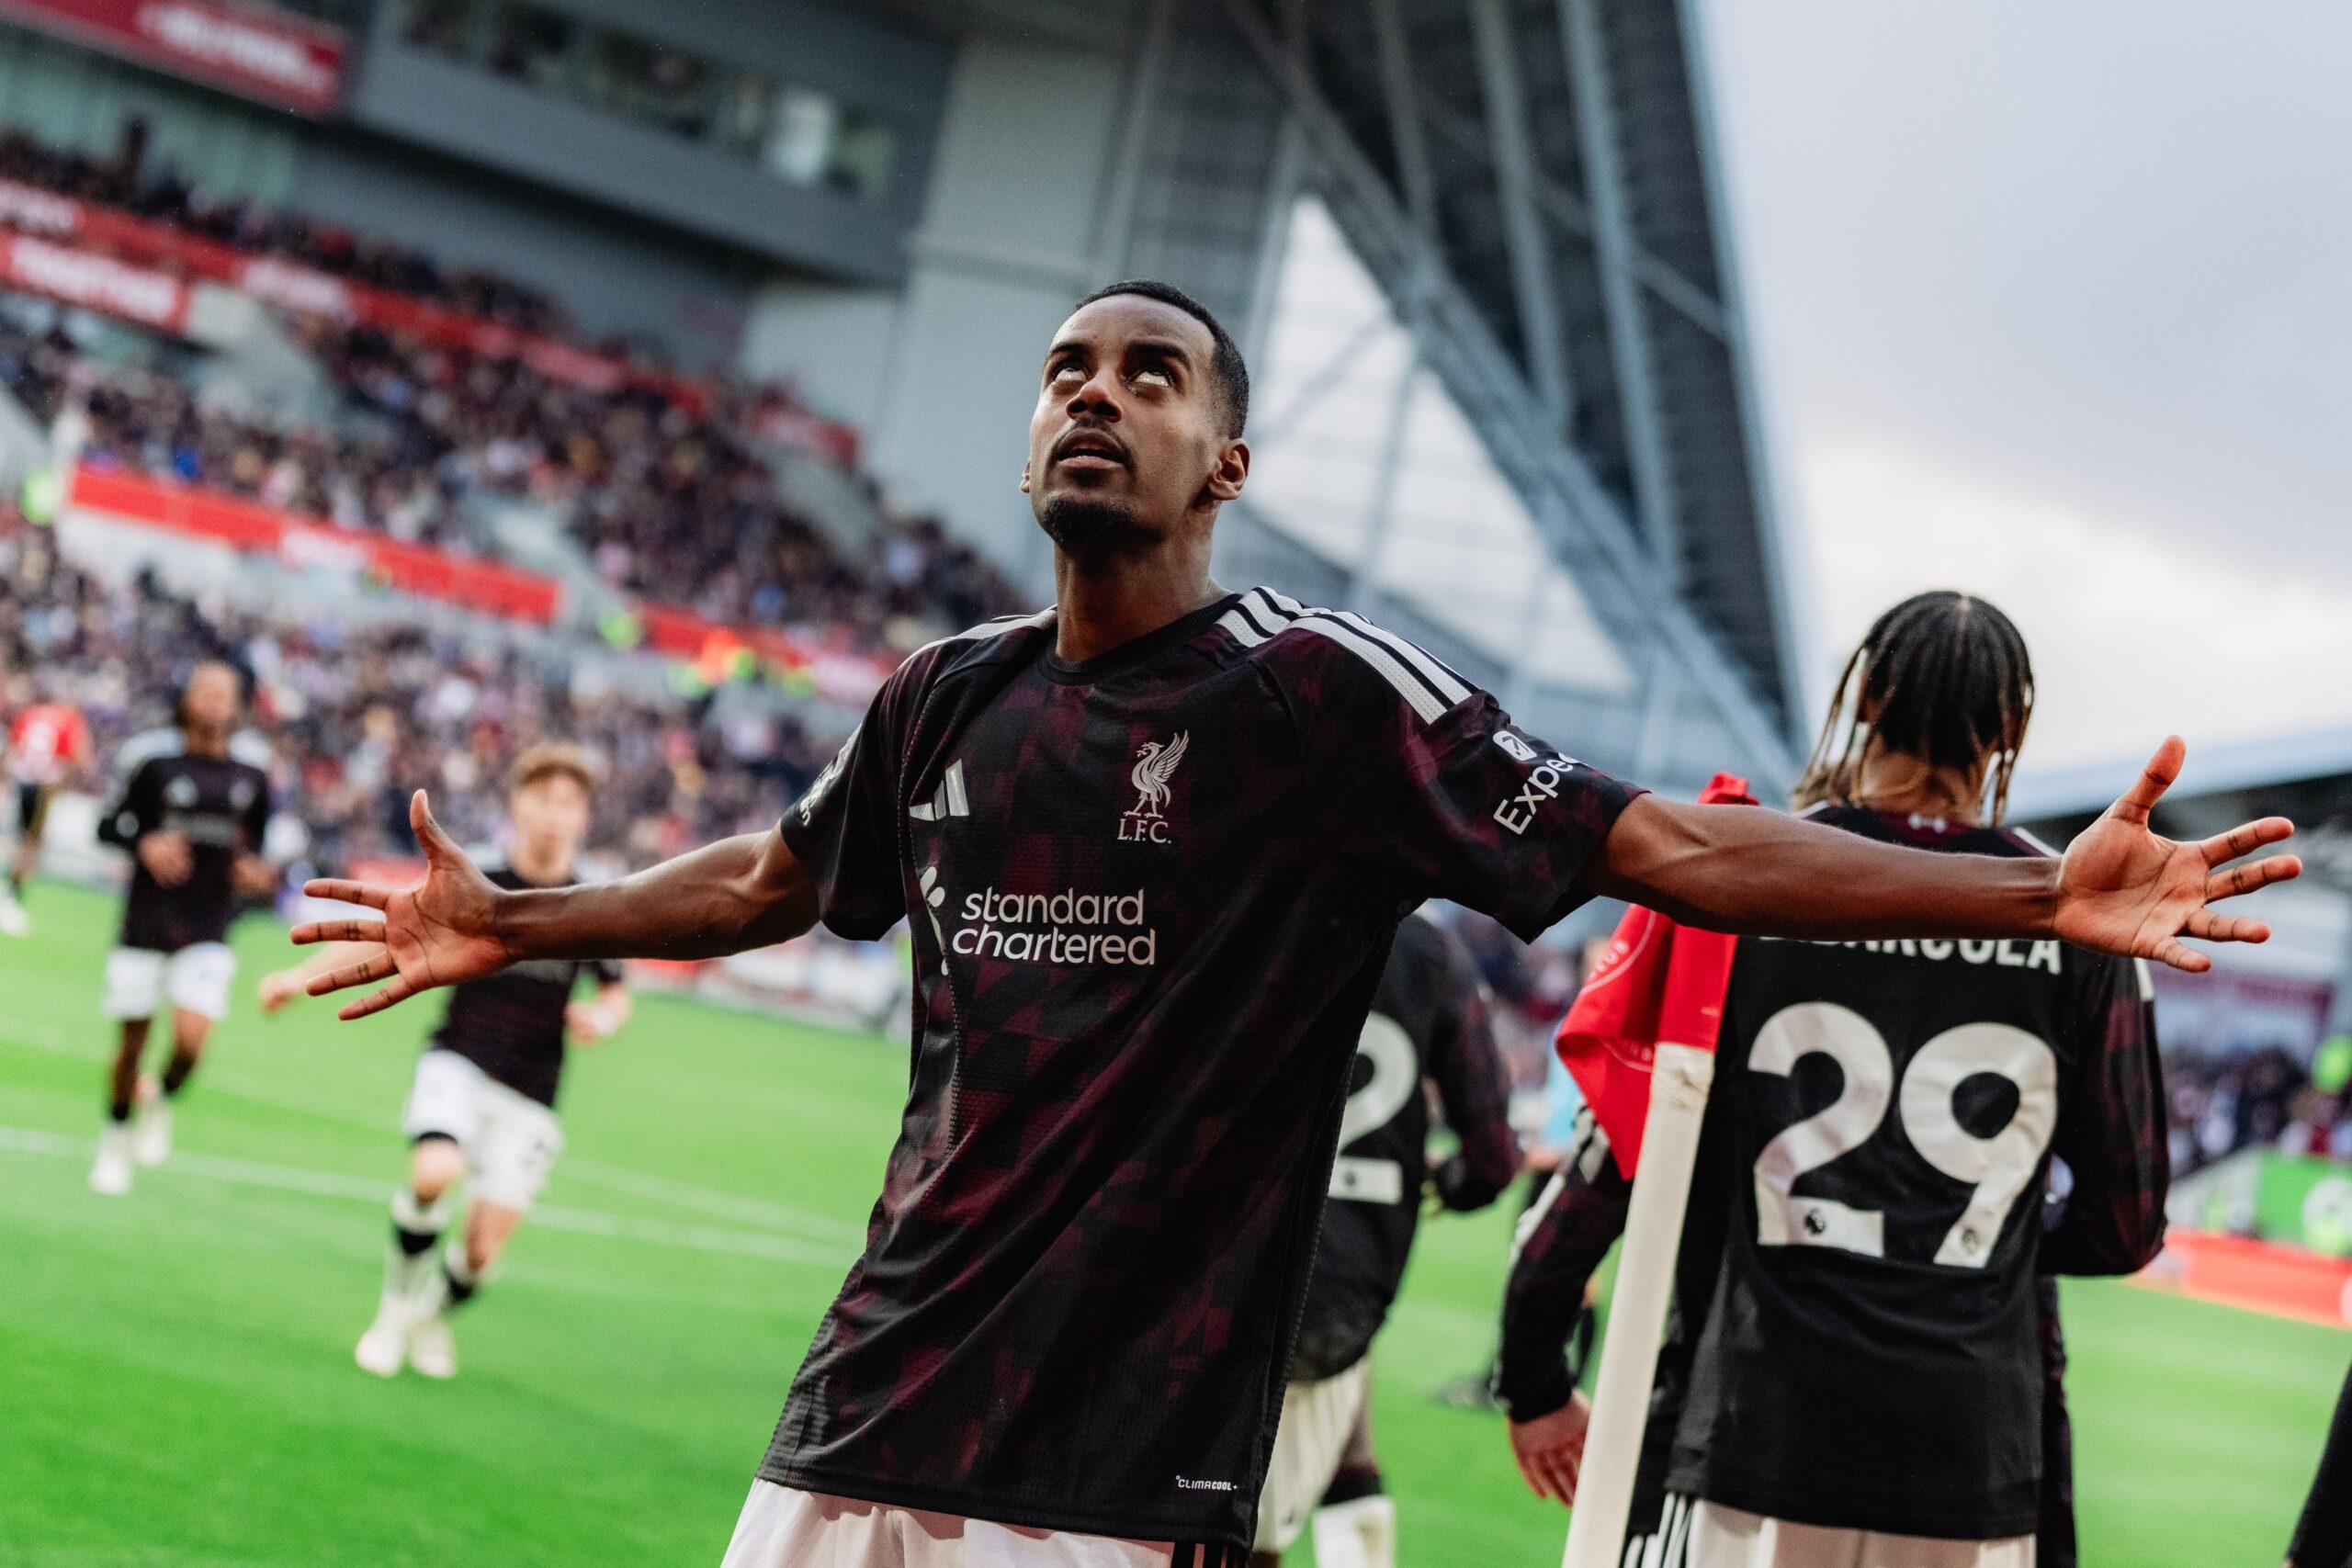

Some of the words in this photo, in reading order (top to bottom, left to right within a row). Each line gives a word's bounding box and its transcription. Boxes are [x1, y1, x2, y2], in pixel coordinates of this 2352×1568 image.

[1493, 752, 1580, 835] Expe
[1117, 818, 1172, 844] L.F.C.
[961, 886, 1144, 926] standard
[952, 923, 1156, 965] chartered
[1747, 1001, 2059, 1269] 29
